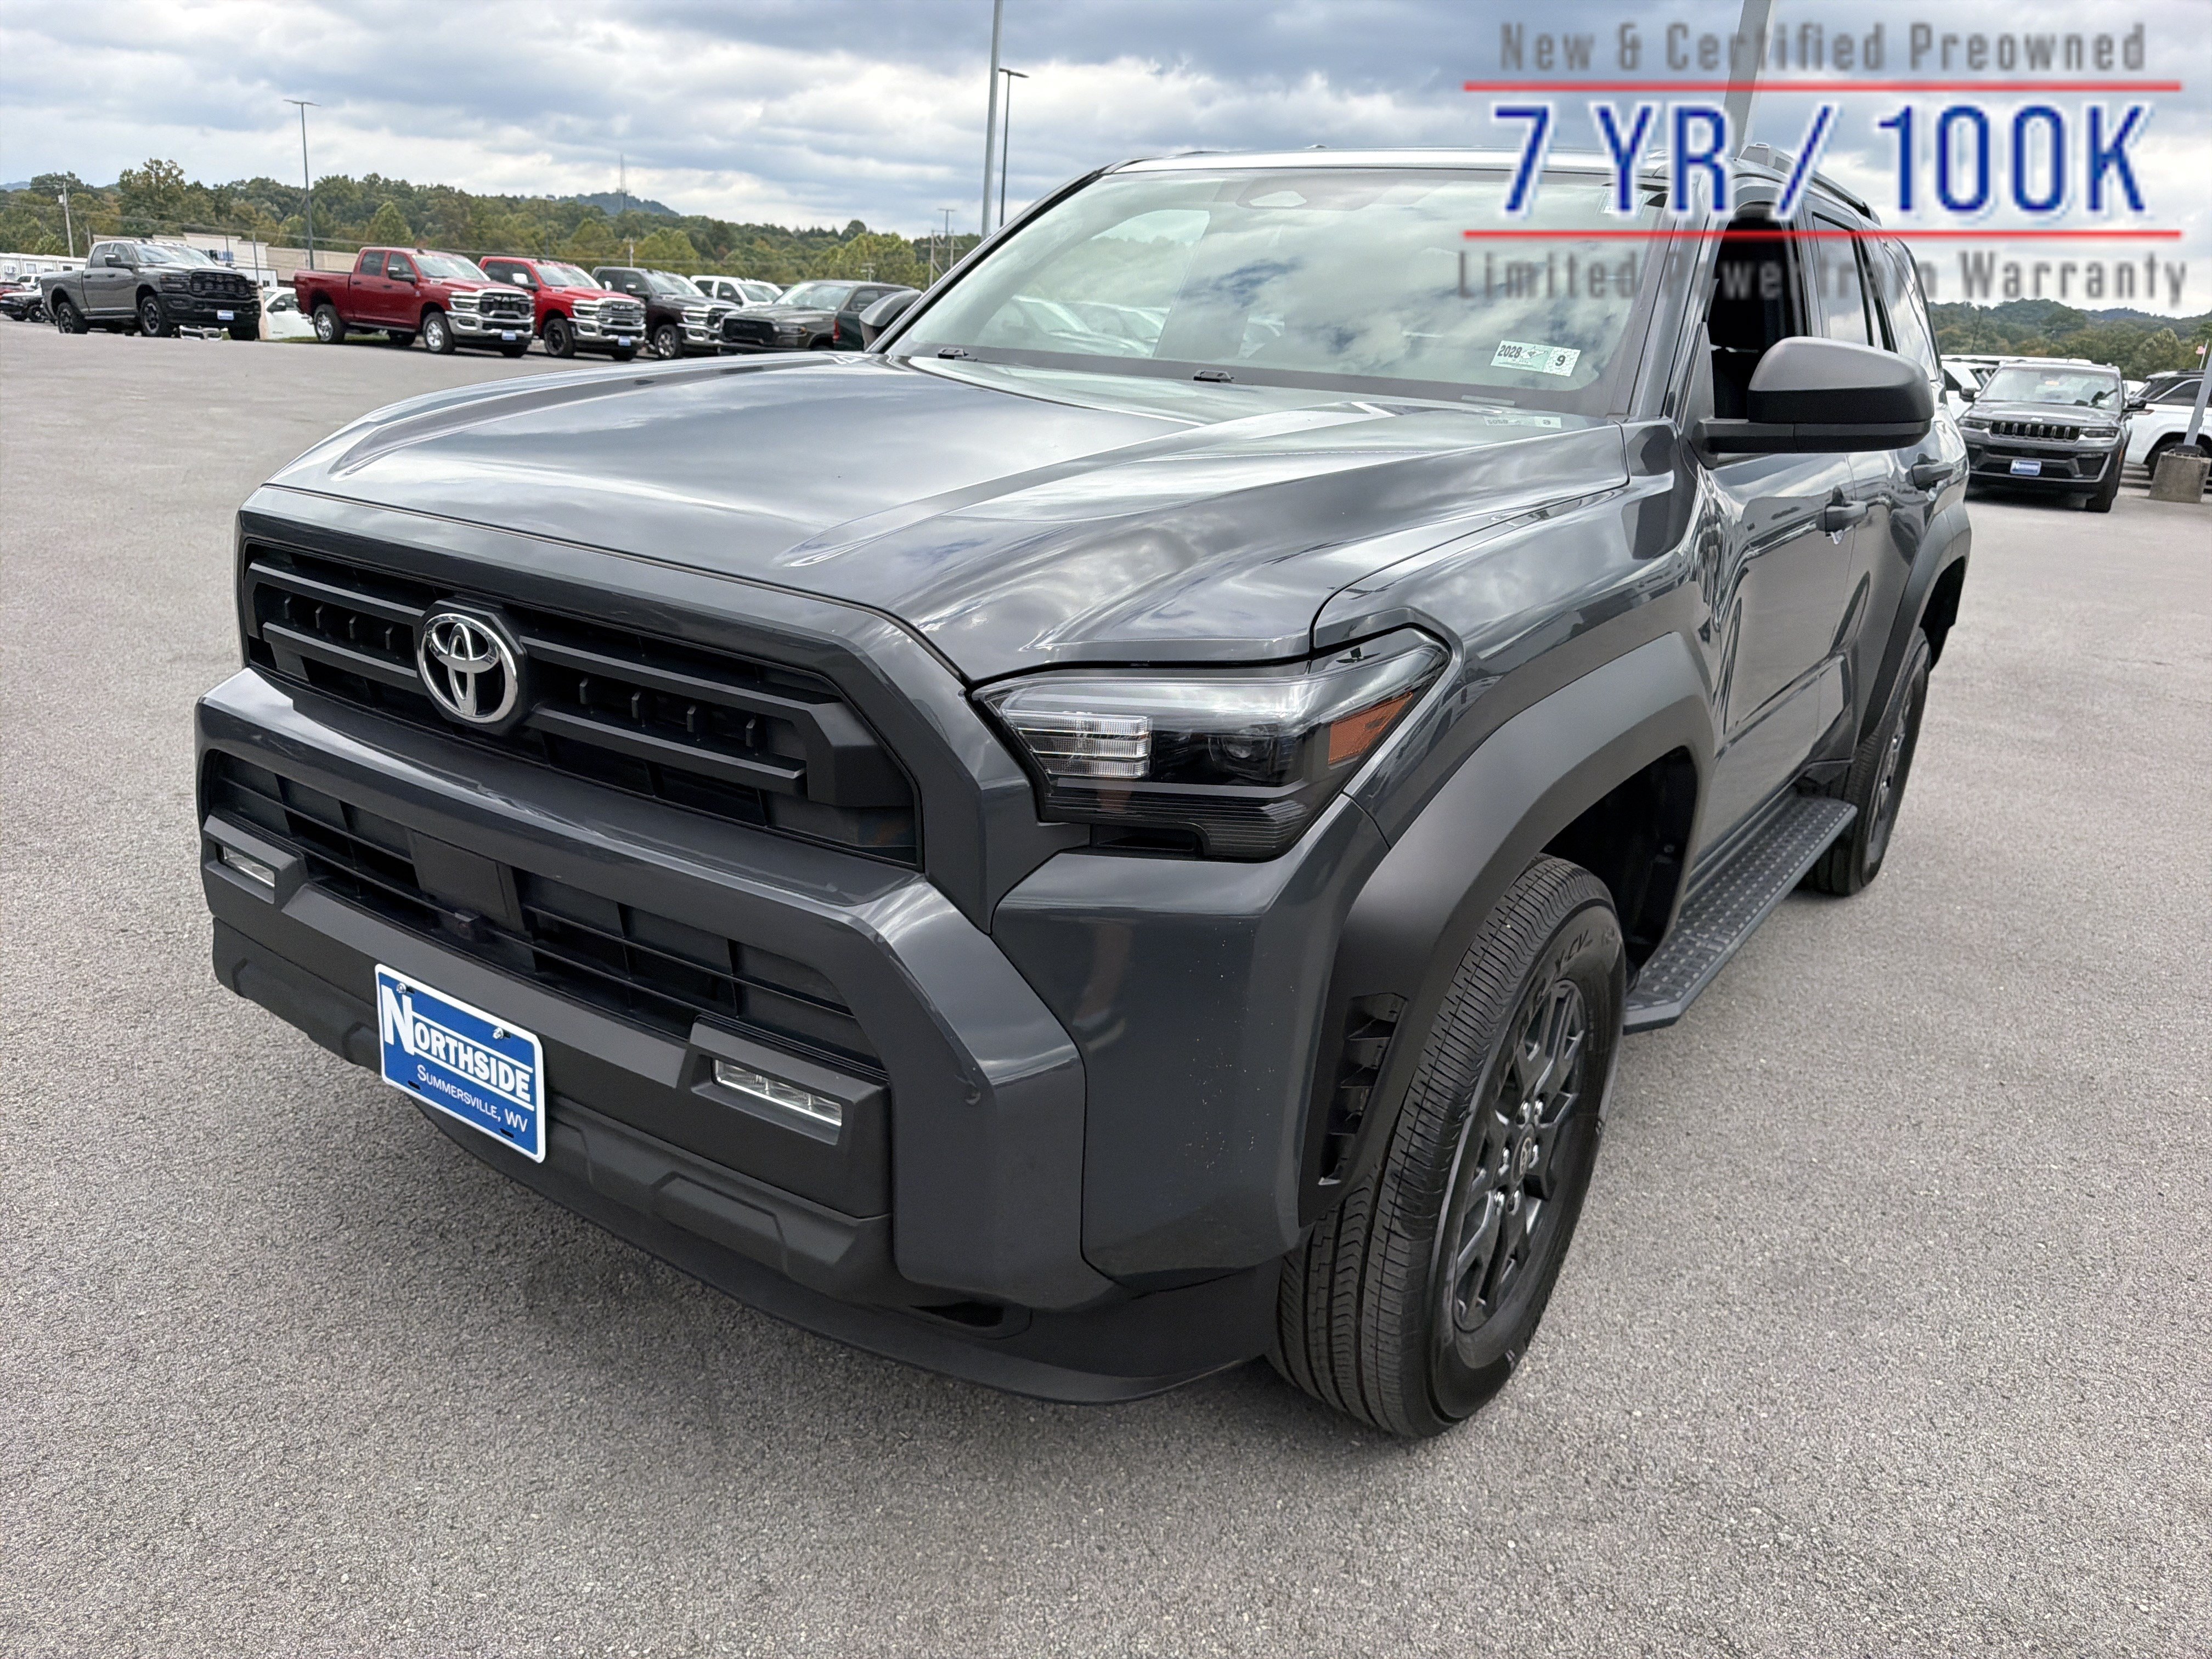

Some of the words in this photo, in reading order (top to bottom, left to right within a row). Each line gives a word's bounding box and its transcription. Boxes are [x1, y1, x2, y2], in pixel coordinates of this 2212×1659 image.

[1497, 345, 1523, 359] 2028
[1555, 354, 1566, 366] 9
[381, 984, 531, 1103] NORTHSIDE
[505, 1108, 529, 1132] WV
